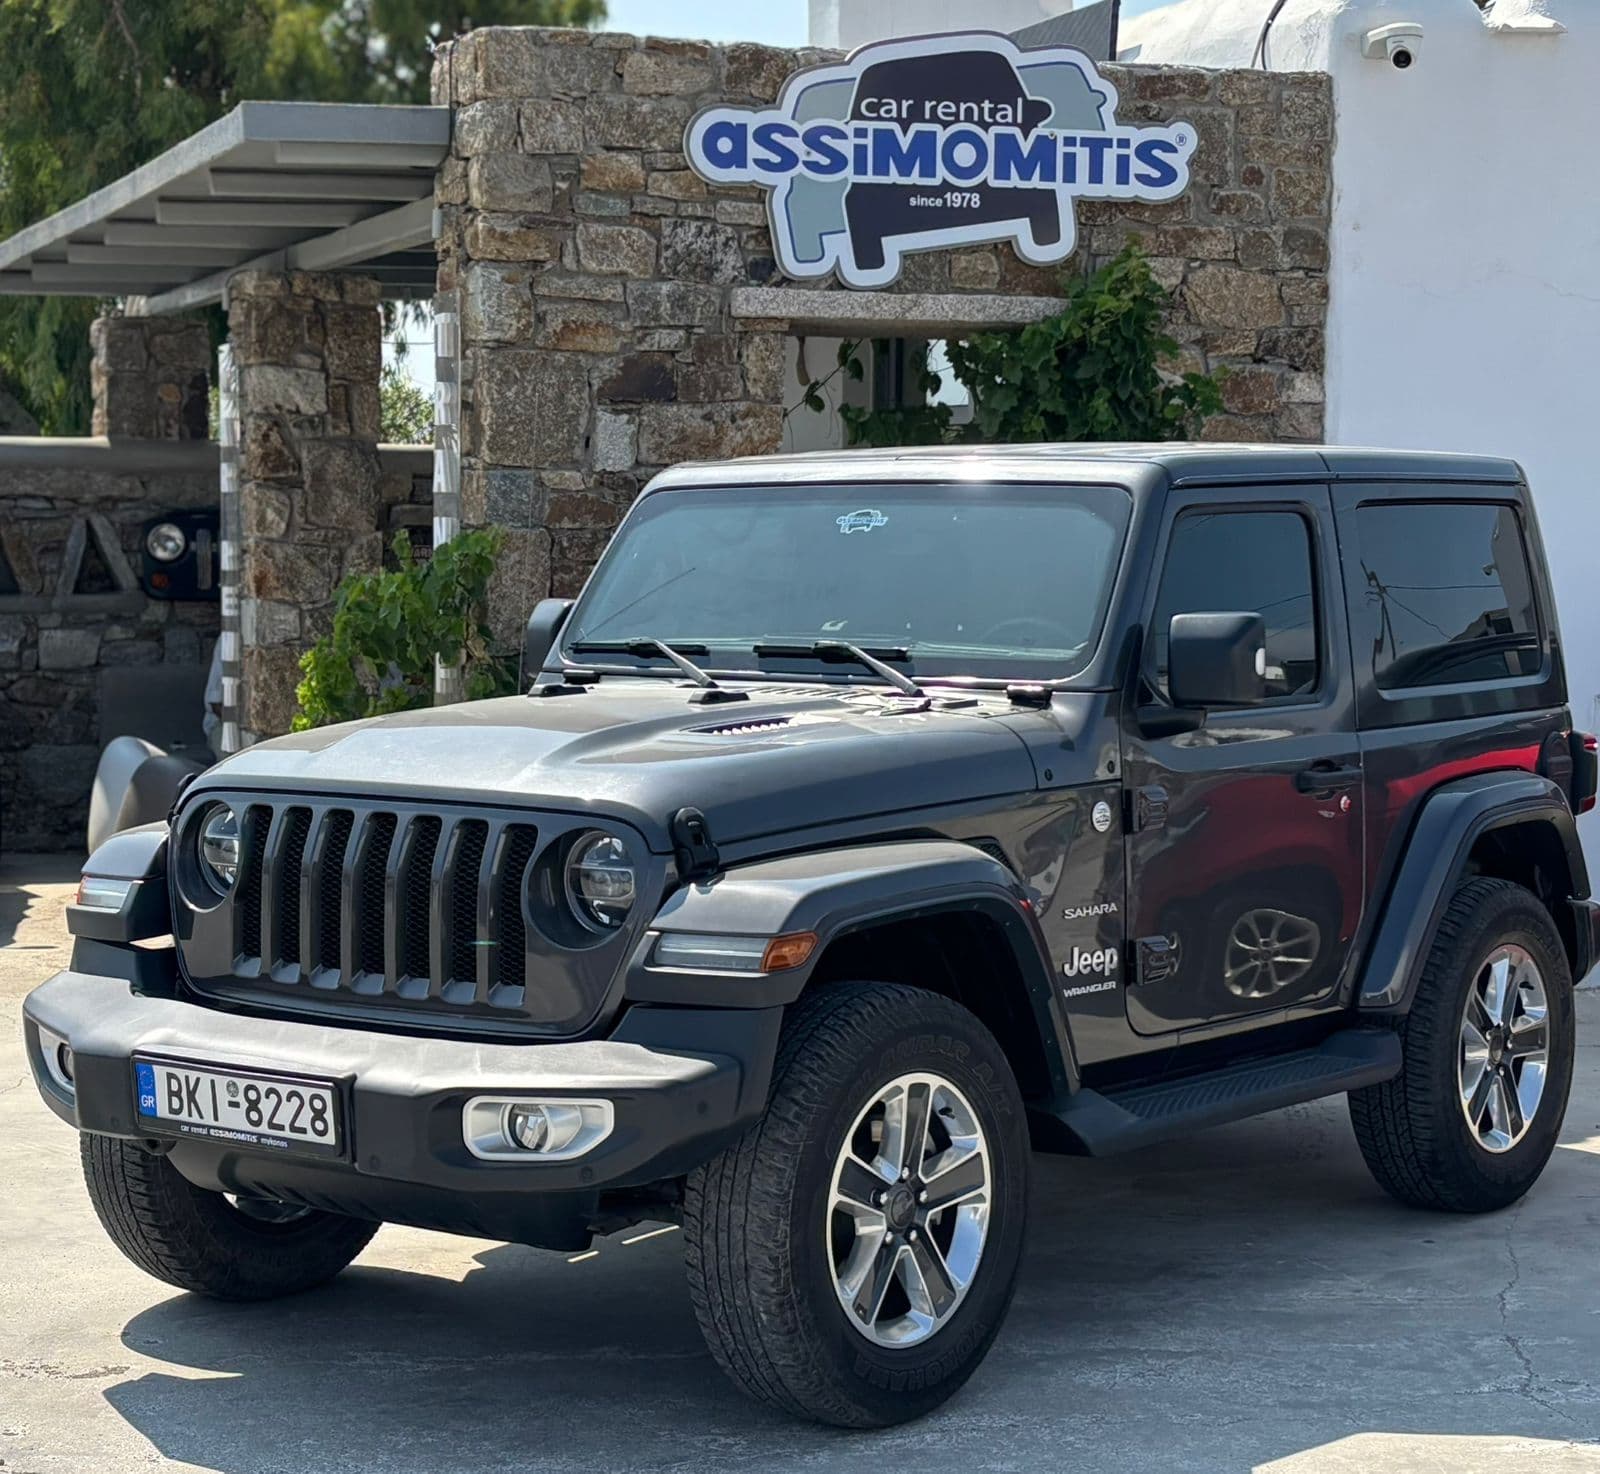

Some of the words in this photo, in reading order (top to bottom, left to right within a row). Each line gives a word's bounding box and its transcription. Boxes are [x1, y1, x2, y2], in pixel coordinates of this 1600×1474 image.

[860, 97, 914, 121] car
[925, 97, 1023, 124] rental
[909, 194, 943, 207] since
[943, 191, 981, 208] 1978
[1063, 902, 1118, 920] SAHARA
[1062, 946, 1119, 977] Jeep
[1062, 980, 1117, 998] WRANGLER
[140, 1094, 155, 1109] GR
